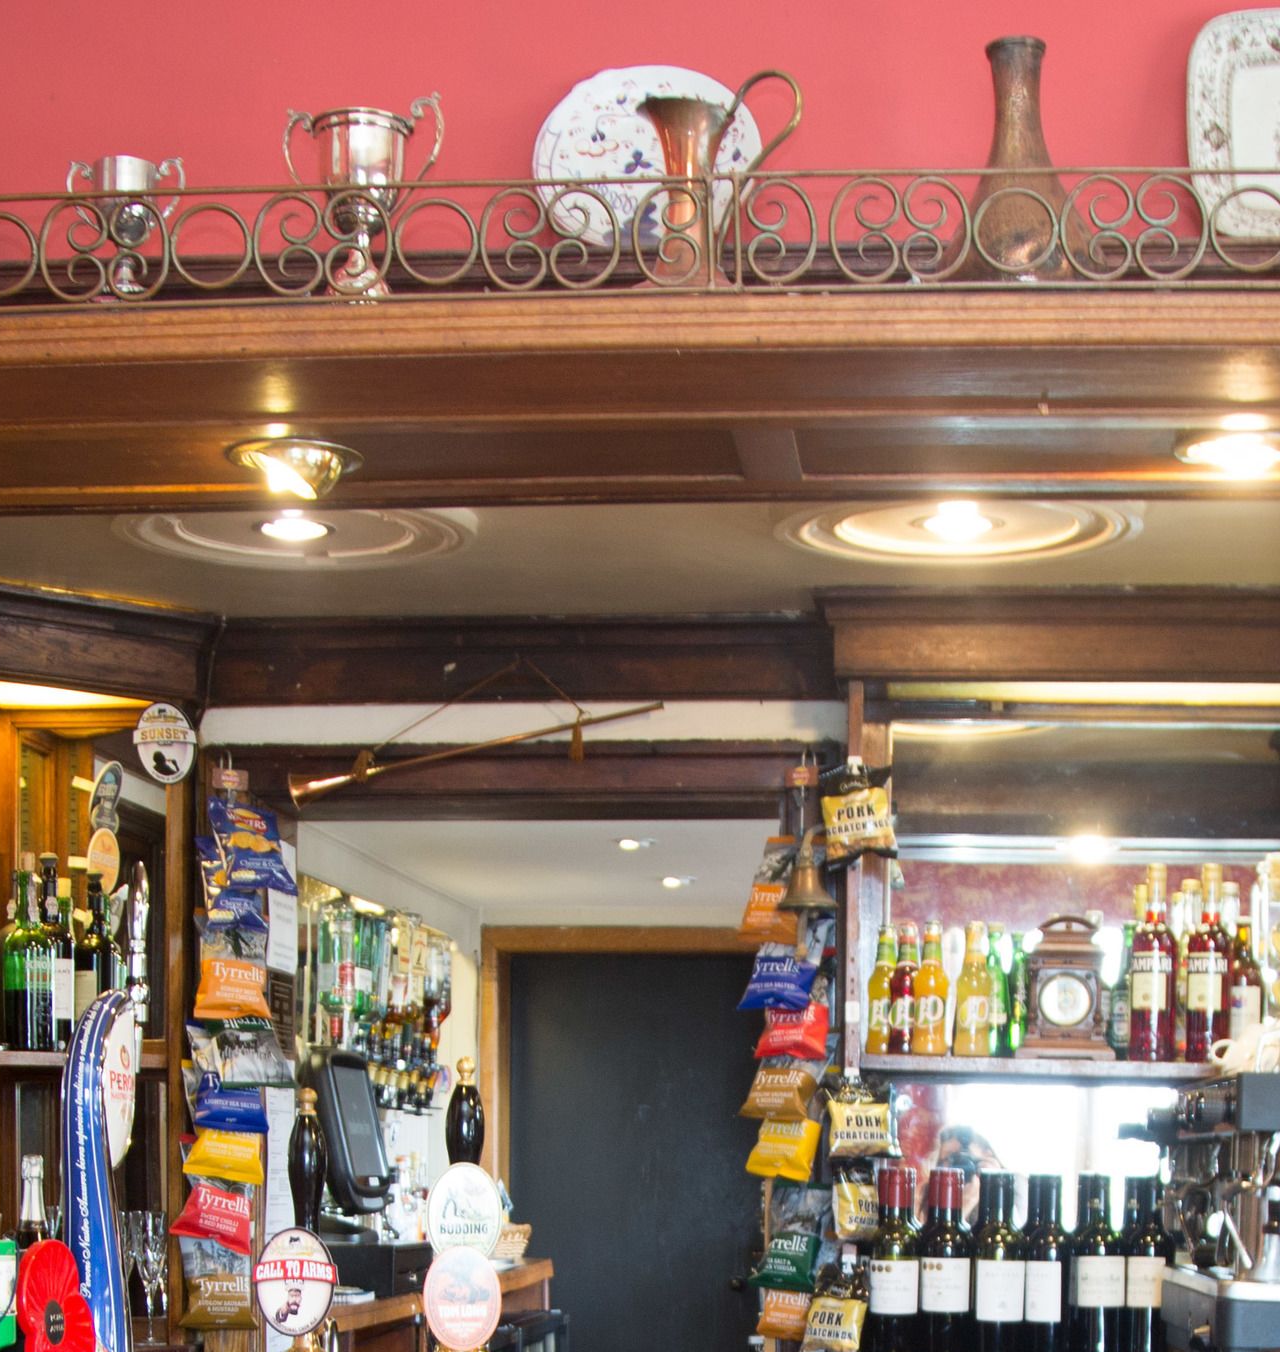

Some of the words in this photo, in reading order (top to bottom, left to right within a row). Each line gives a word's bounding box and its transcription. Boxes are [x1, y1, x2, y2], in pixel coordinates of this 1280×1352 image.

[141, 728, 188, 741] SUNSET
[837, 802, 875, 821] PORK
[211, 961, 265, 982] Tyrrells
[846, 1115, 882, 1127] PORK
[77, 1171, 90, 1217] Azzurro
[197, 1187, 250, 1216] Tyrrells
[440, 1223, 488, 1235] BUDDING
[77, 1218, 91, 1260] Nastro
[771, 1235, 808, 1251] rrells
[80, 1260, 92, 1299] Peroni
[256, 1262, 283, 1280] CALL
[286, 1261, 300, 1277] TO
[302, 1261, 333, 1280] ARMS
[196, 1277, 251, 1298] Tyrrells
[811, 1310, 845, 1327] PORK
